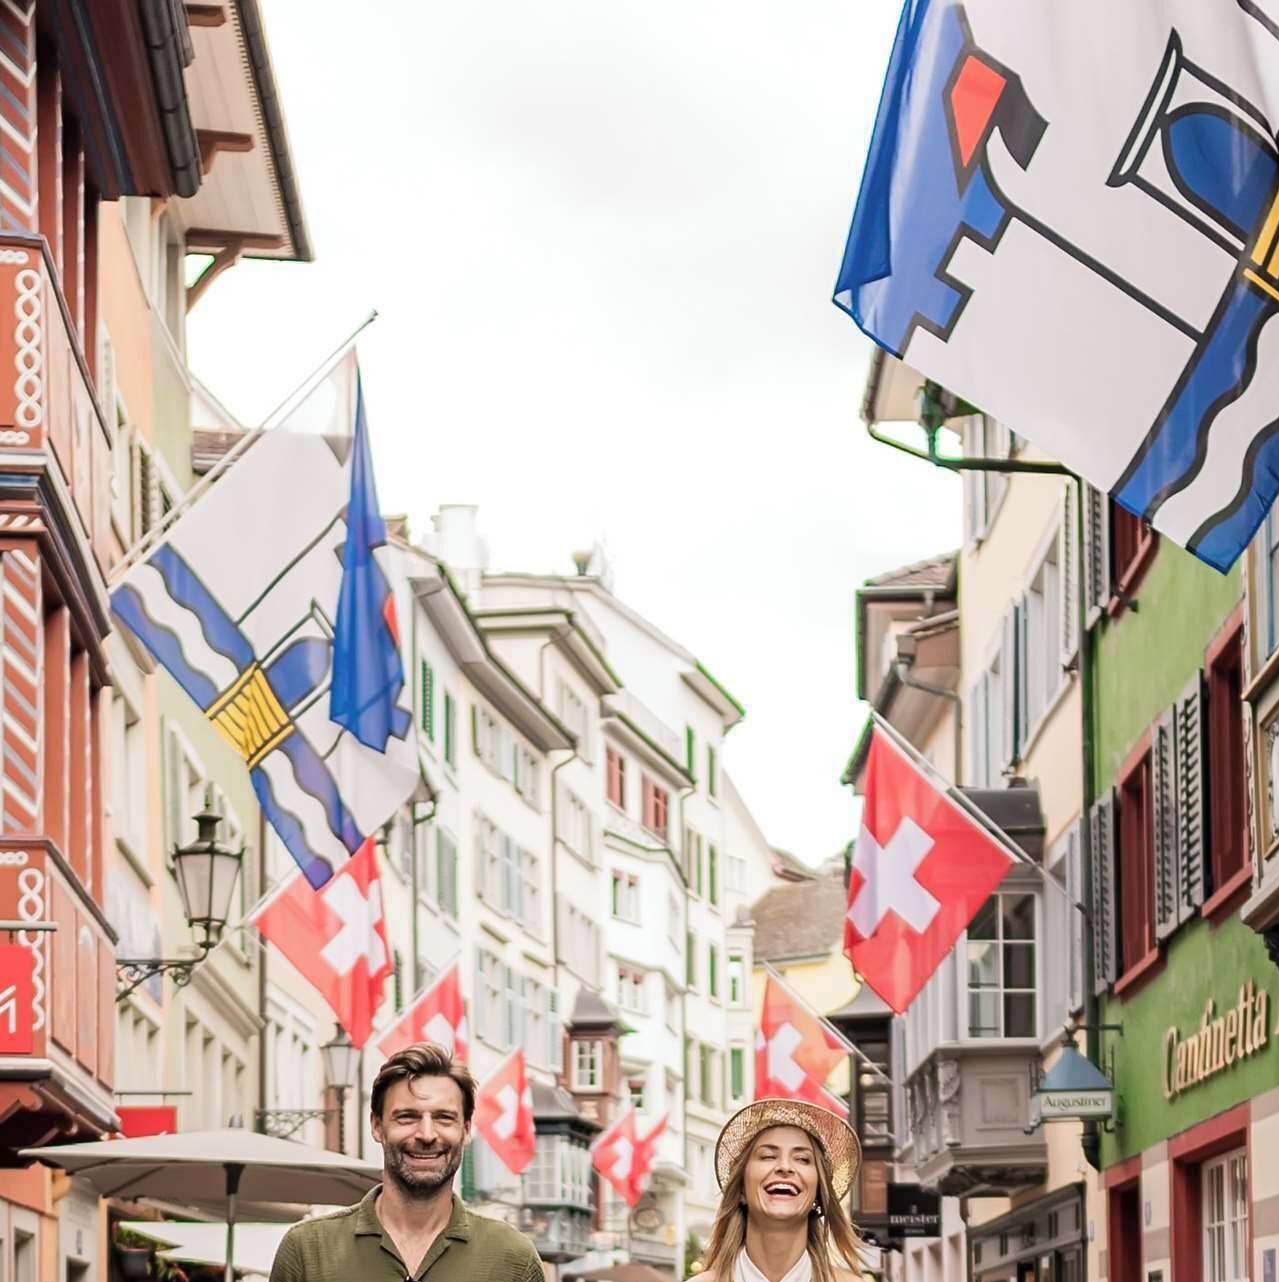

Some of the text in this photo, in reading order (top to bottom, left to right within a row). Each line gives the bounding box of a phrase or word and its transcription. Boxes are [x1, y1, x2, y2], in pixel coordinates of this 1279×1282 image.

[1163, 976, 1268, 1099] Cantinetta
[1045, 1095, 1106, 1111] Augustiner
[890, 1213, 938, 1225] meister
